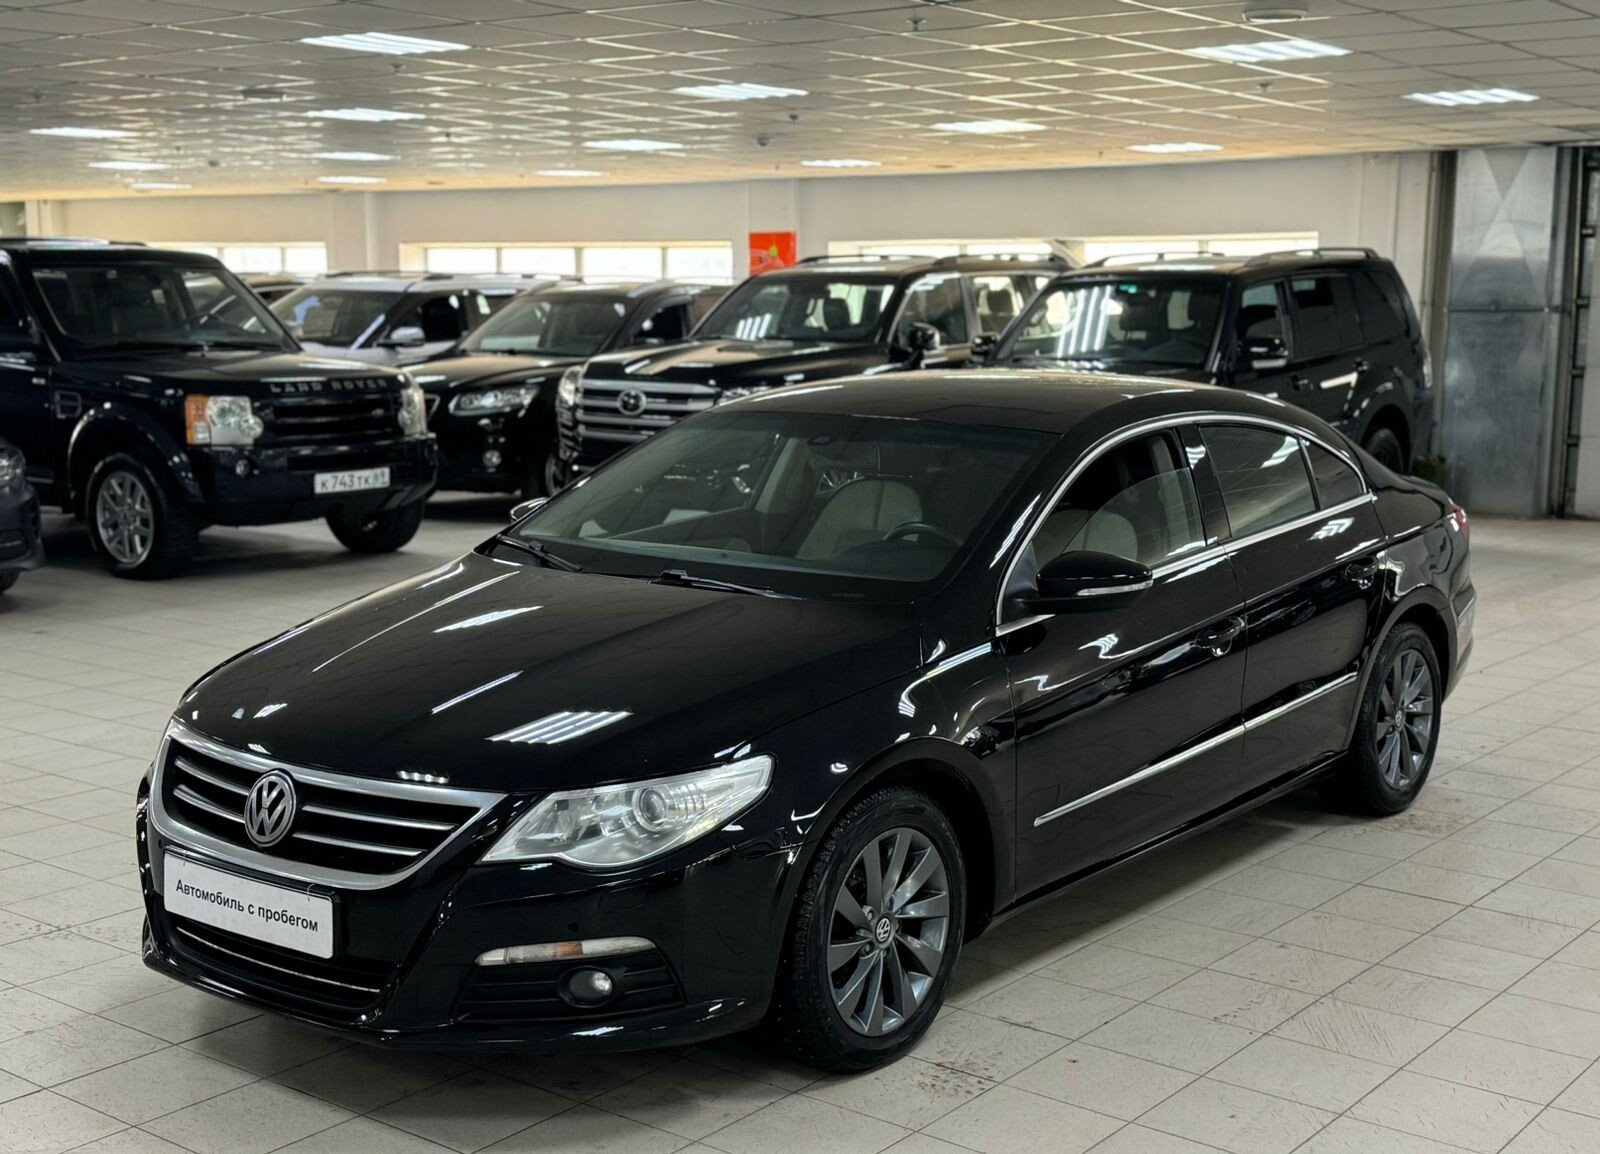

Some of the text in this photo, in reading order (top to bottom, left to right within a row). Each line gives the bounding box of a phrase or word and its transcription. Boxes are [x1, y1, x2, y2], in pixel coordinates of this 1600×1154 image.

[270, 380, 387, 393] LAND ROVER
[176, 879, 318, 932] Автомобиль с пробегом
